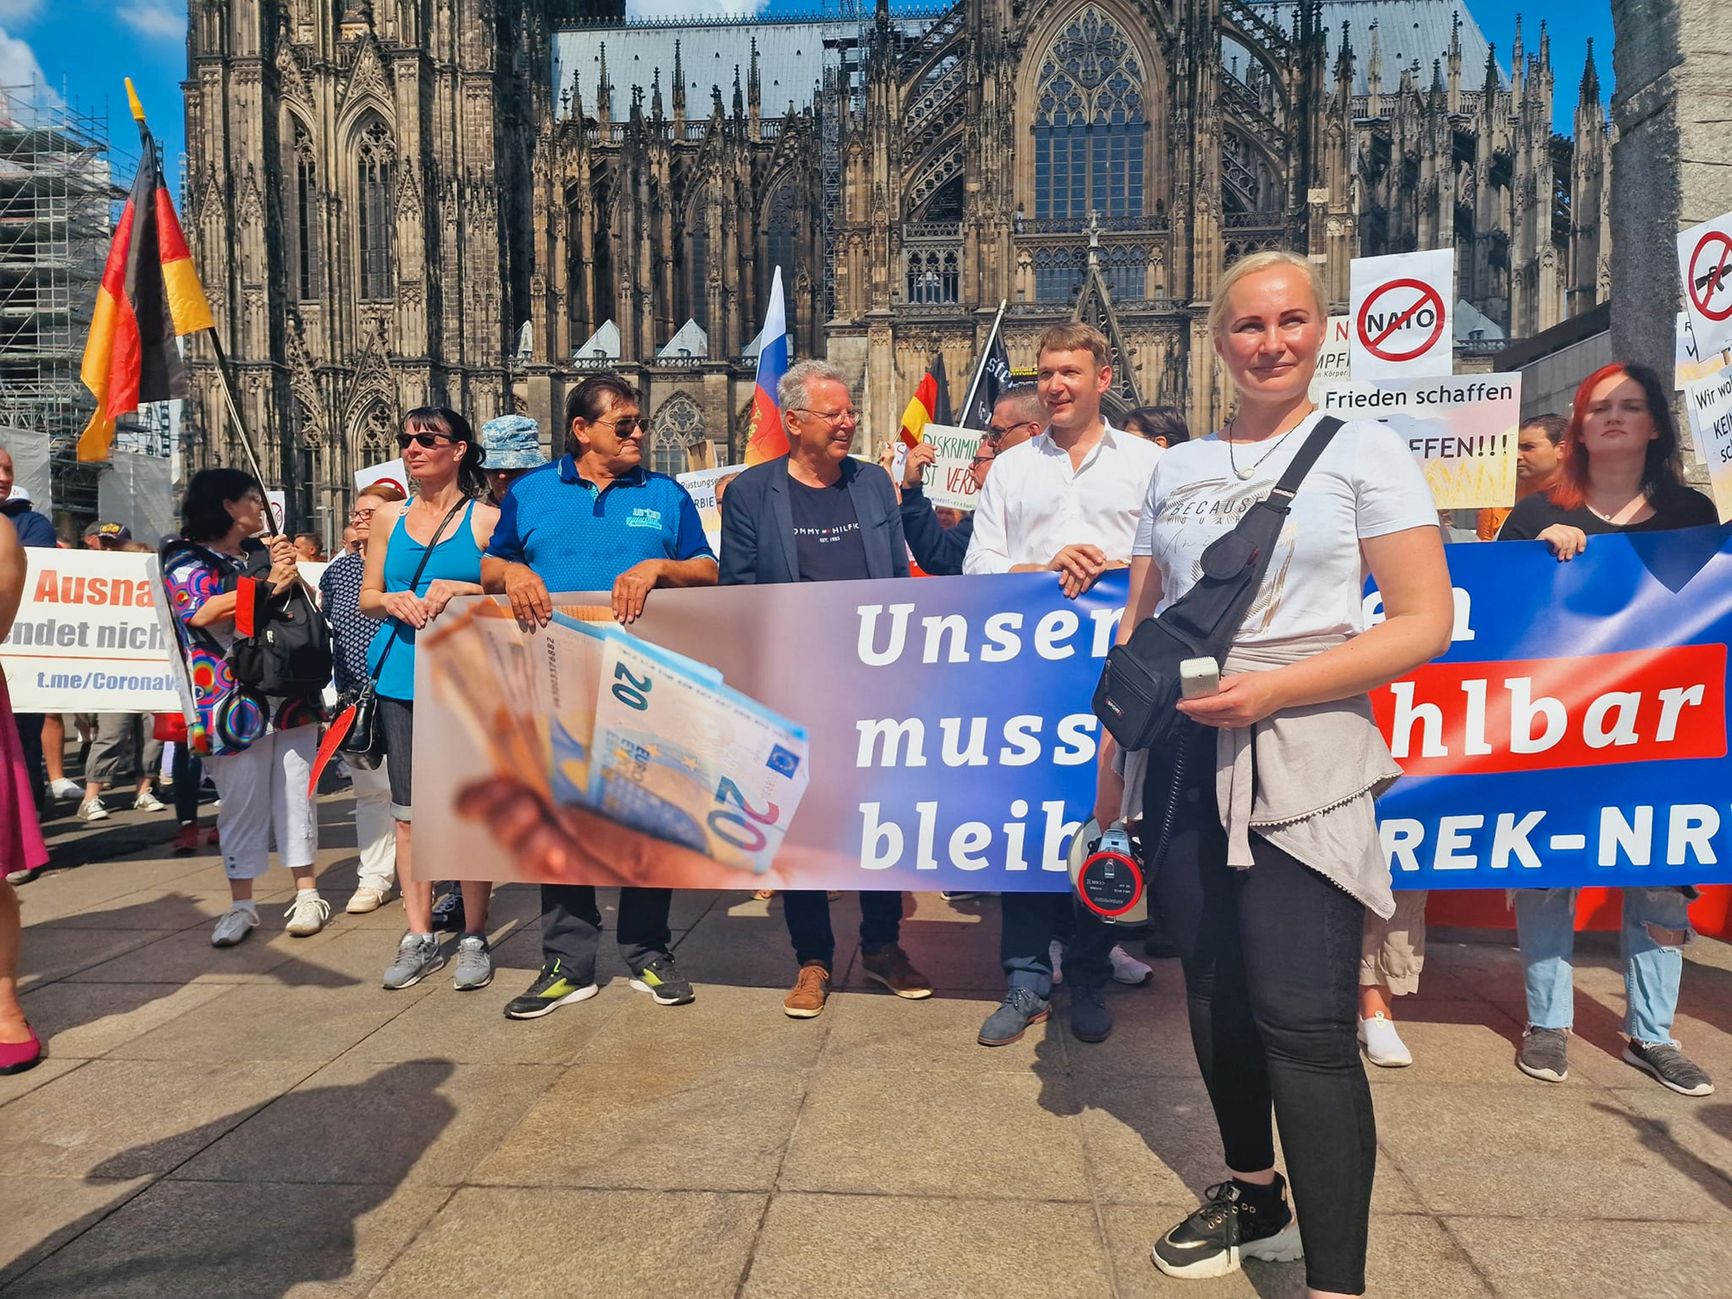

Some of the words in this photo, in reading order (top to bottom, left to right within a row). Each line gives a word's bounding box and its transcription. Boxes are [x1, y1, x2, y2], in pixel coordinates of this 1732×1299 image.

[1367, 309, 1435, 332] NATO
[1326, 390, 1406, 408] Frieden
[1416, 383, 1512, 404] schaffen
[1696, 389, 1715, 410] Wir
[922, 465, 939, 487] ST
[1170, 496, 1264, 516] BECAUS
[33, 569, 157, 608] Ausna
[2, 618, 90, 648] ndet
[856, 602, 1127, 667] Unser
[37, 671, 182, 691] t.me/CoronaV
[611, 660, 653, 712] 20
[855, 711, 1096, 768] muss
[706, 775, 780, 853] 20
[1379, 803, 1732, 872] REK-NR
